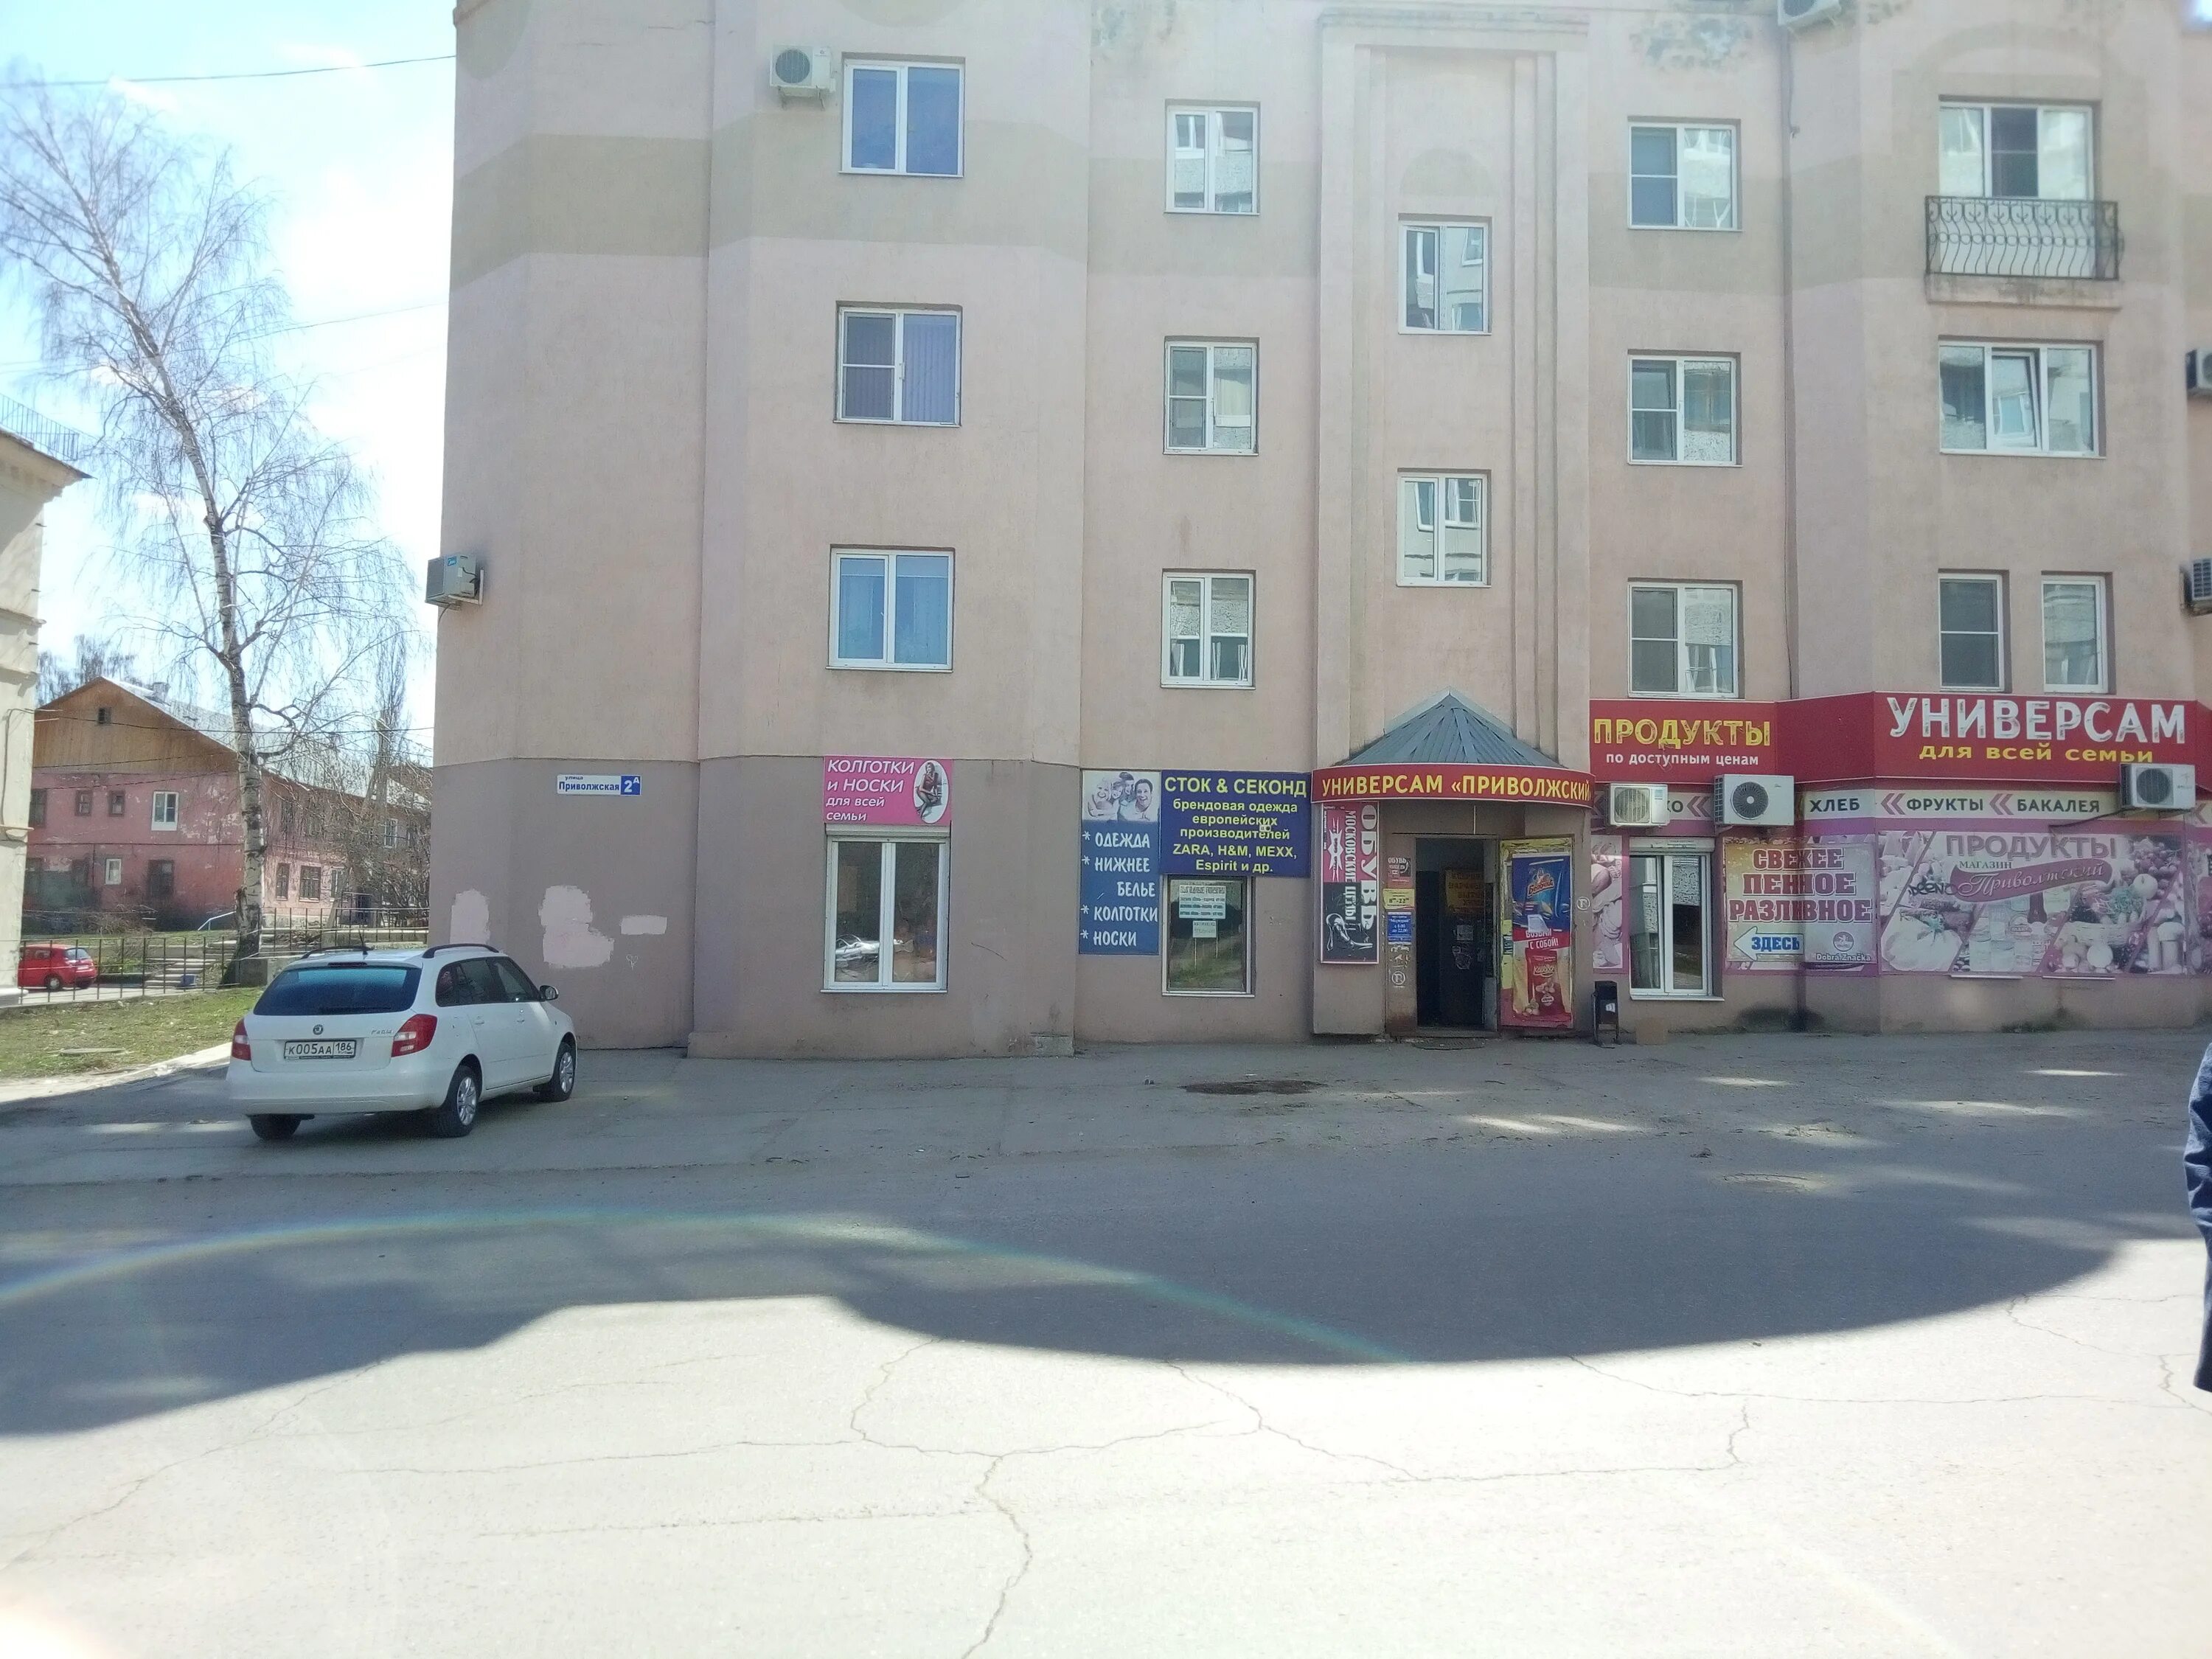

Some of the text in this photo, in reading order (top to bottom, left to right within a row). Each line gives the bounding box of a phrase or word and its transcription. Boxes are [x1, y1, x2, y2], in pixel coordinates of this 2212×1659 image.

[1886, 696, 2186, 744] УНИВЕРСАМ
[1593, 718, 1771, 750] ПРОДУКТЫ
[1606, 753, 1759, 767] по доступным ценам
[1919, 742, 2154, 763] для всей семьи
[827, 759, 916, 774] КОЛГОТКИ
[558, 781, 619, 792] Приволжская
[827, 779, 904, 793] и НОСКИ
[1164, 776, 1307, 798] СТОК & СЕКОНД
[1322, 774, 1443, 797] УНИВЕРСАМ
[825, 796, 885, 807] для всей
[1173, 799, 1298, 813] брендовая одежда
[1809, 798, 1860, 813] ХЛЕБ
[1906, 797, 1983, 813] ФРУКТЫ
[2017, 799, 2100, 813] БАКАЛЕЯ
[826, 811, 867, 821] семьи
[1192, 814, 1278, 828] европейских
[1095, 832, 1150, 848] ОДЕЖДА
[1180, 828, 1290, 841] производителей
[1172, 844, 1297, 860] ZARA, H&M, MEXX,
[1345, 810, 1357, 883] МОСКОВСКИЕ
[1946, 834, 2117, 861] ПРОДУКТЫ
[1094, 857, 1150, 873] НИЖНЕЕ
[1196, 859, 1273, 874] Espirit и др.
[1361, 804, 1377, 931] ОБУВЬ
[1753, 848, 1845, 871] СВЕЖЕЕ
[1959, 860, 2012, 869] МАГАЗИН
[1116, 881, 1155, 897] БЕЛЬЕ
[1742, 872, 1857, 897] ПЕННОЕ
[1093, 905, 1158, 922] КОЛГОТКИ
[1728, 898, 1873, 923] РАЗЛИВНОЕ
[1093, 931, 1137, 947] НОСКИ
[1529, 937, 1559, 950] С СОБОЙ!
[1751, 936, 1800, 952] ЗДЕСЬ
[1841, 953, 1871, 961] Značka
[335, 1043, 352, 1051] 186
